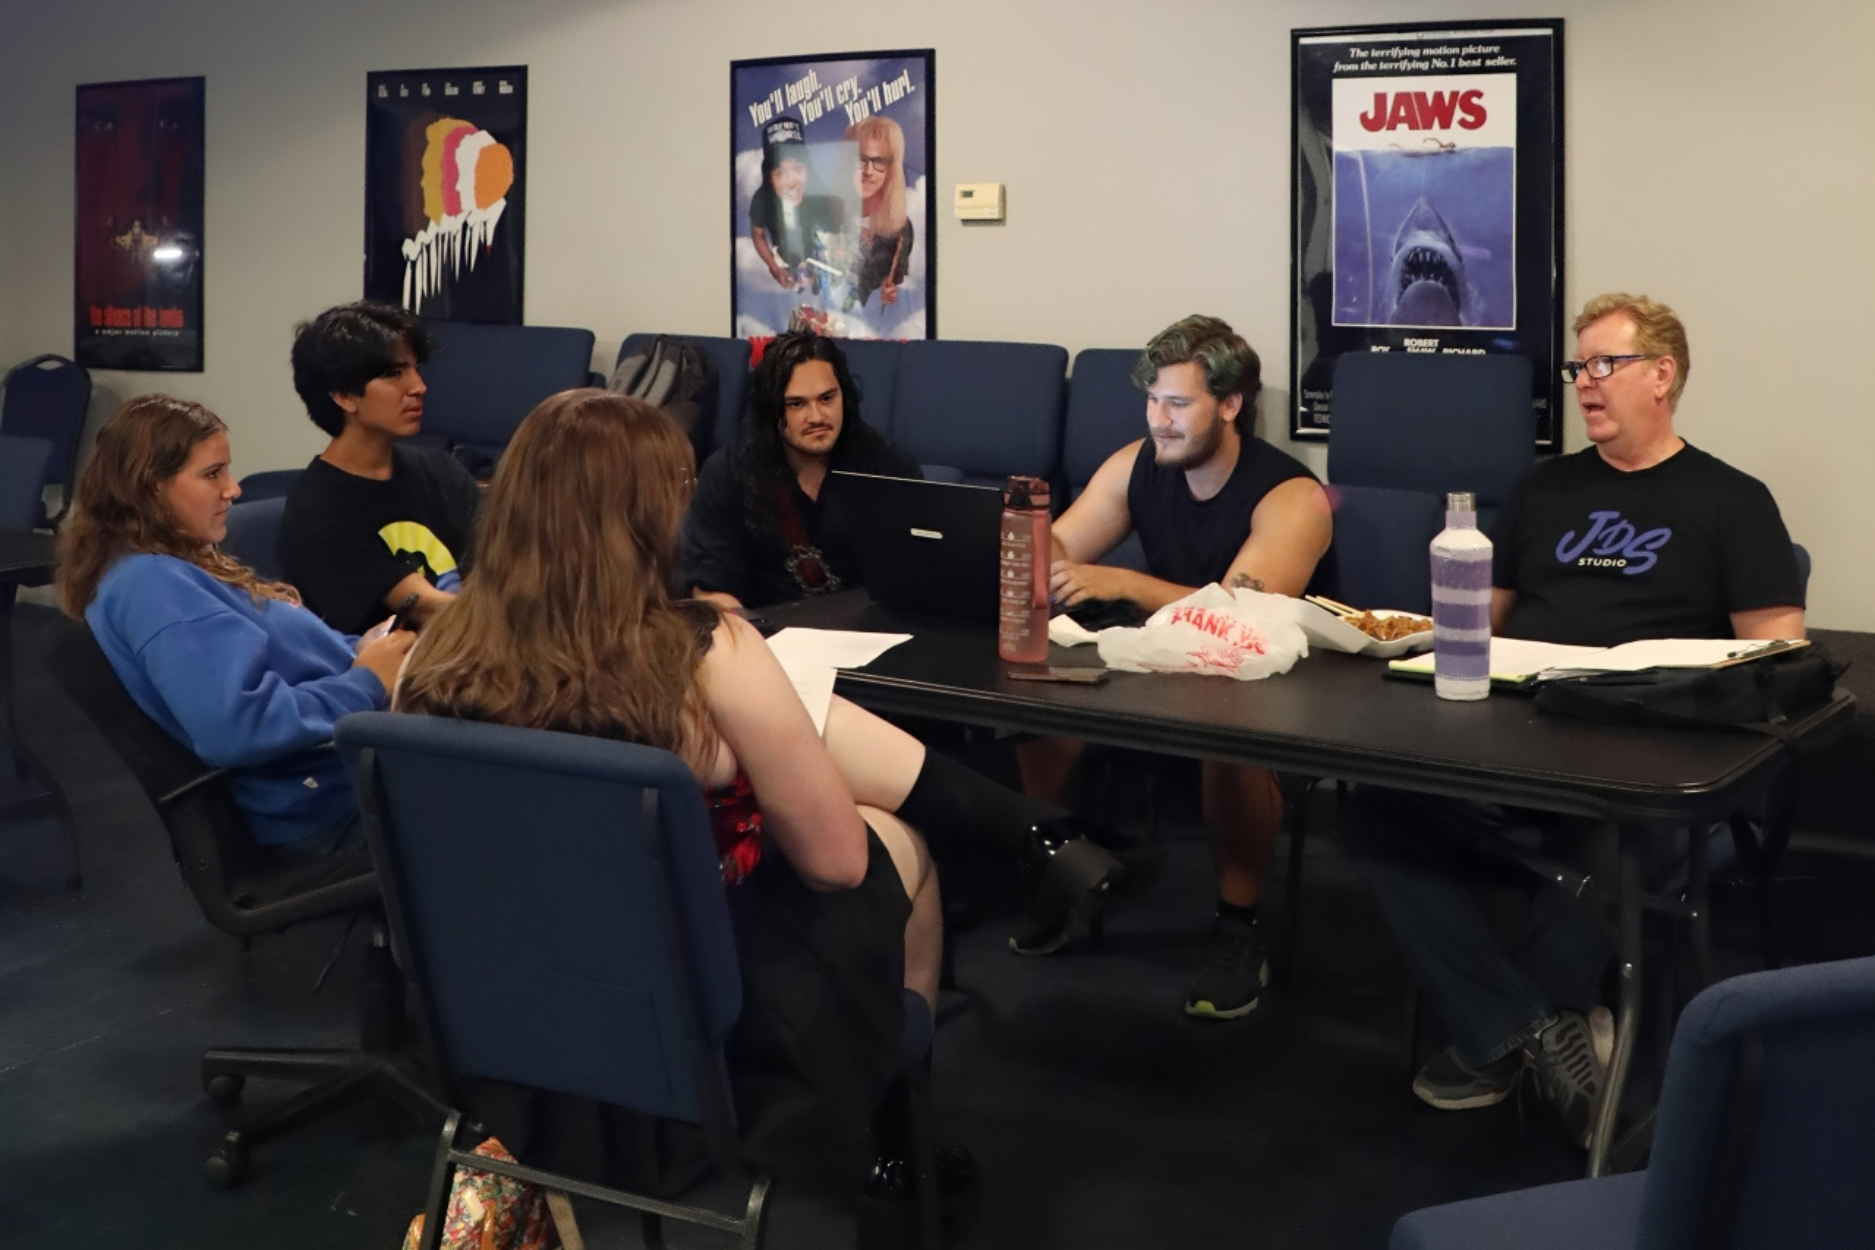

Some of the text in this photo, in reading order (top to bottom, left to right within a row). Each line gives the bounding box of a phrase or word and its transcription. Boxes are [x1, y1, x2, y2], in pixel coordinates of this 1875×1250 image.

[1333, 61, 1358, 73] from
[1360, 60, 1377, 70] the
[1379, 59, 1429, 71] terrifying
[1458, 57, 1481, 68] best
[1484, 55, 1517, 67] seller.
[1349, 44, 1500, 58] The terrifying motion picture
[748, 69, 823, 128] You'll laugh.
[798, 75, 863, 126] You'll cry.
[844, 68, 916, 126] You'll hurl.
[1359, 89, 1488, 132] JAWS
[1403, 338, 1440, 348] ROBERT
[1555, 510, 1672, 575] JDS
[1577, 557, 1628, 567] STUDIO
